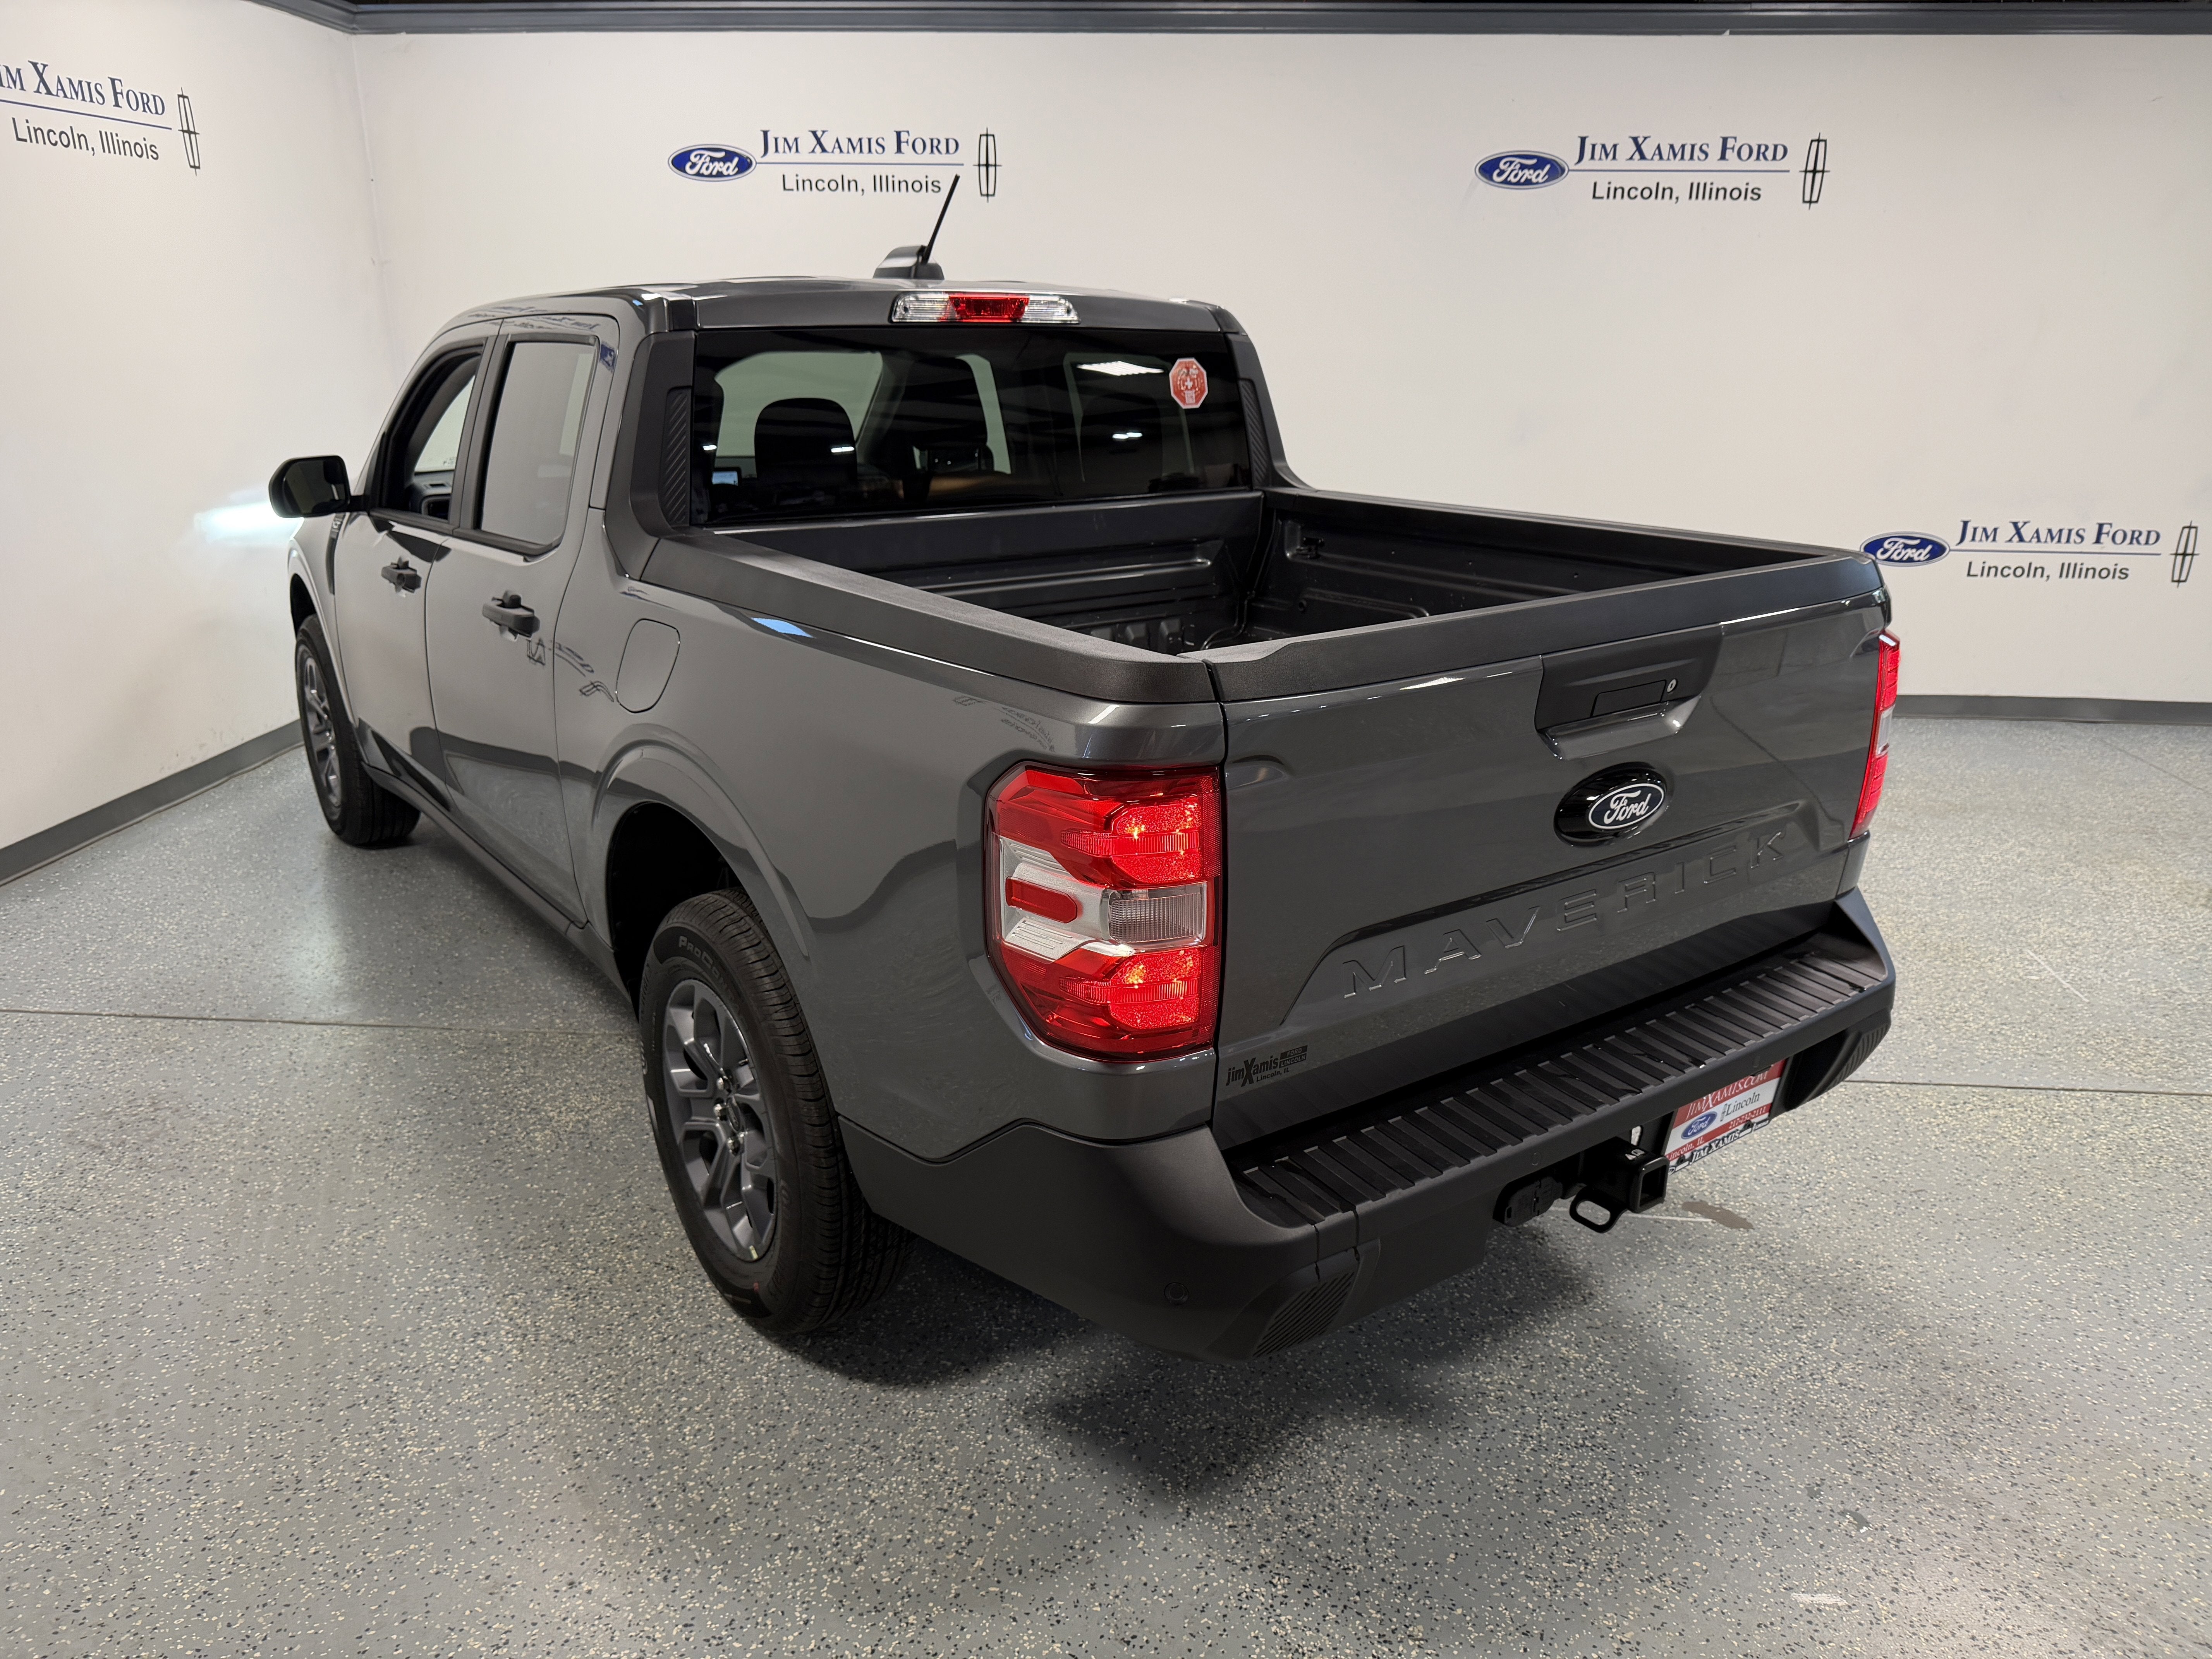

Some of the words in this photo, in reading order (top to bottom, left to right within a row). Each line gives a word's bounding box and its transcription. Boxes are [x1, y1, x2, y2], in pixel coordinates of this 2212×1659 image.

[0, 64, 26, 91] IM
[28, 60, 105, 105] XAMIS
[108, 76, 165, 115] FORD
[12, 117, 95, 156] Lincoln,
[99, 130, 159, 160] Illinois
[760, 130, 800, 158] JIM
[808, 130, 886, 155] XAMIS
[894, 130, 959, 155] FORD
[1574, 136, 1619, 165] JIM
[1626, 136, 1709, 161] XAMIS
[1717, 136, 1788, 161] FORD
[684, 149, 738, 176] Ford
[1492, 156, 1550, 184] Ford
[782, 174, 864, 196] Lincoln,
[873, 175, 941, 193] Illinois
[1592, 181, 1679, 204] Lincoln,
[1688, 182, 1761, 201] Illinois
[1955, 520, 1999, 546] JIM
[2005, 520, 2086, 544] XAMIS
[2092, 522, 2161, 546] FORD
[1876, 537, 1932, 563] Ford
[1967, 561, 2050, 582] Lincoln,
[2059, 562, 2129, 580] Illinois
[1604, 790, 1652, 824] Ford
[1342, 830, 1785, 998] MAVERICK
[1280, 1054, 1306, 1067] LINCOLN
[1287, 1048, 1302, 1057] FORD
[1256, 1070, 1282, 1082] Lincoln,
[1724, 1091, 1760, 1116] Lincoln
[1687, 1115, 1712, 1135] Ford
[1666, 1143, 1695, 1160] incoln,
[1697, 1136, 1705, 1146] IL
[1690, 1147, 1709, 1165] JIM
[1708, 1130, 1740, 1154] XAMIS
